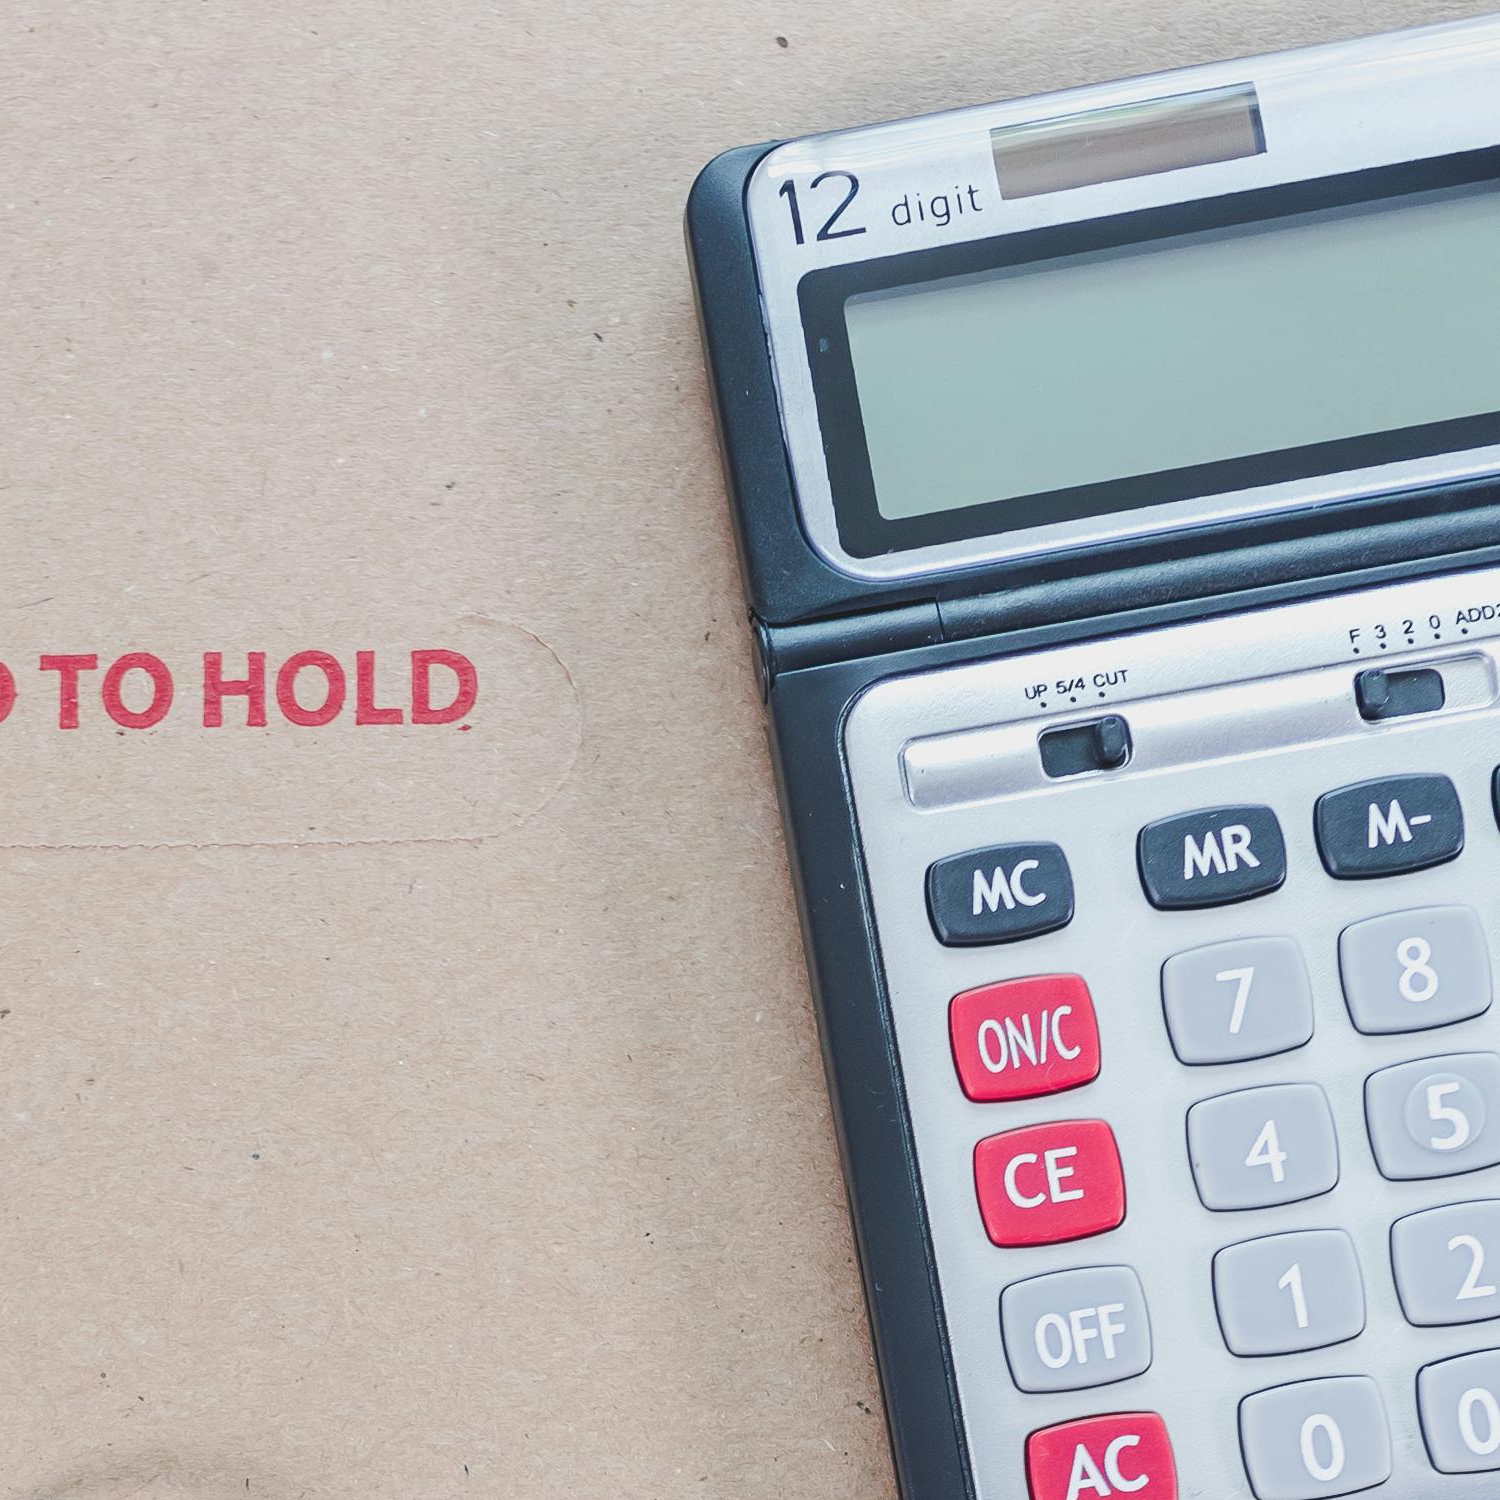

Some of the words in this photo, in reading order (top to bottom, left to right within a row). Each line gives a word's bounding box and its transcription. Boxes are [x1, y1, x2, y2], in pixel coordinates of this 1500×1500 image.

[778, 170, 867, 246] 12
[891, 184, 983, 227] digit
[1349, 629, 1359, 643] F
[1375, 625, 1386, 639] 3
[1403, 620, 1414, 634] 2
[1429, 616, 1440, 629] 0
[39, 653, 173, 729] TO
[203, 649, 477, 728] HOLD
[1025, 685, 1047, 699] UP
[1056, 678, 1085, 694] 5/4
[1092, 669, 1129, 688] CUT
[1184, 825, 1260, 879] MR
[1369, 799, 1431, 848] M-
[972, 857, 1047, 915] MC
[1216, 967, 1254, 1033] 7
[1397, 938, 1438, 1001] 8
[978, 1004, 1082, 1073] ON/C
[1427, 1081, 1470, 1150] 5
[1004, 1147, 1084, 1208] CE
[1245, 1120, 1286, 1182] 4
[1279, 1264, 1308, 1328] 1
[1449, 1235, 1496, 1299] 2
[1036, 1303, 1125, 1368] OFF
[1066, 1435, 1149, 1500] AC
[1301, 1414, 1344, 1480] 0
